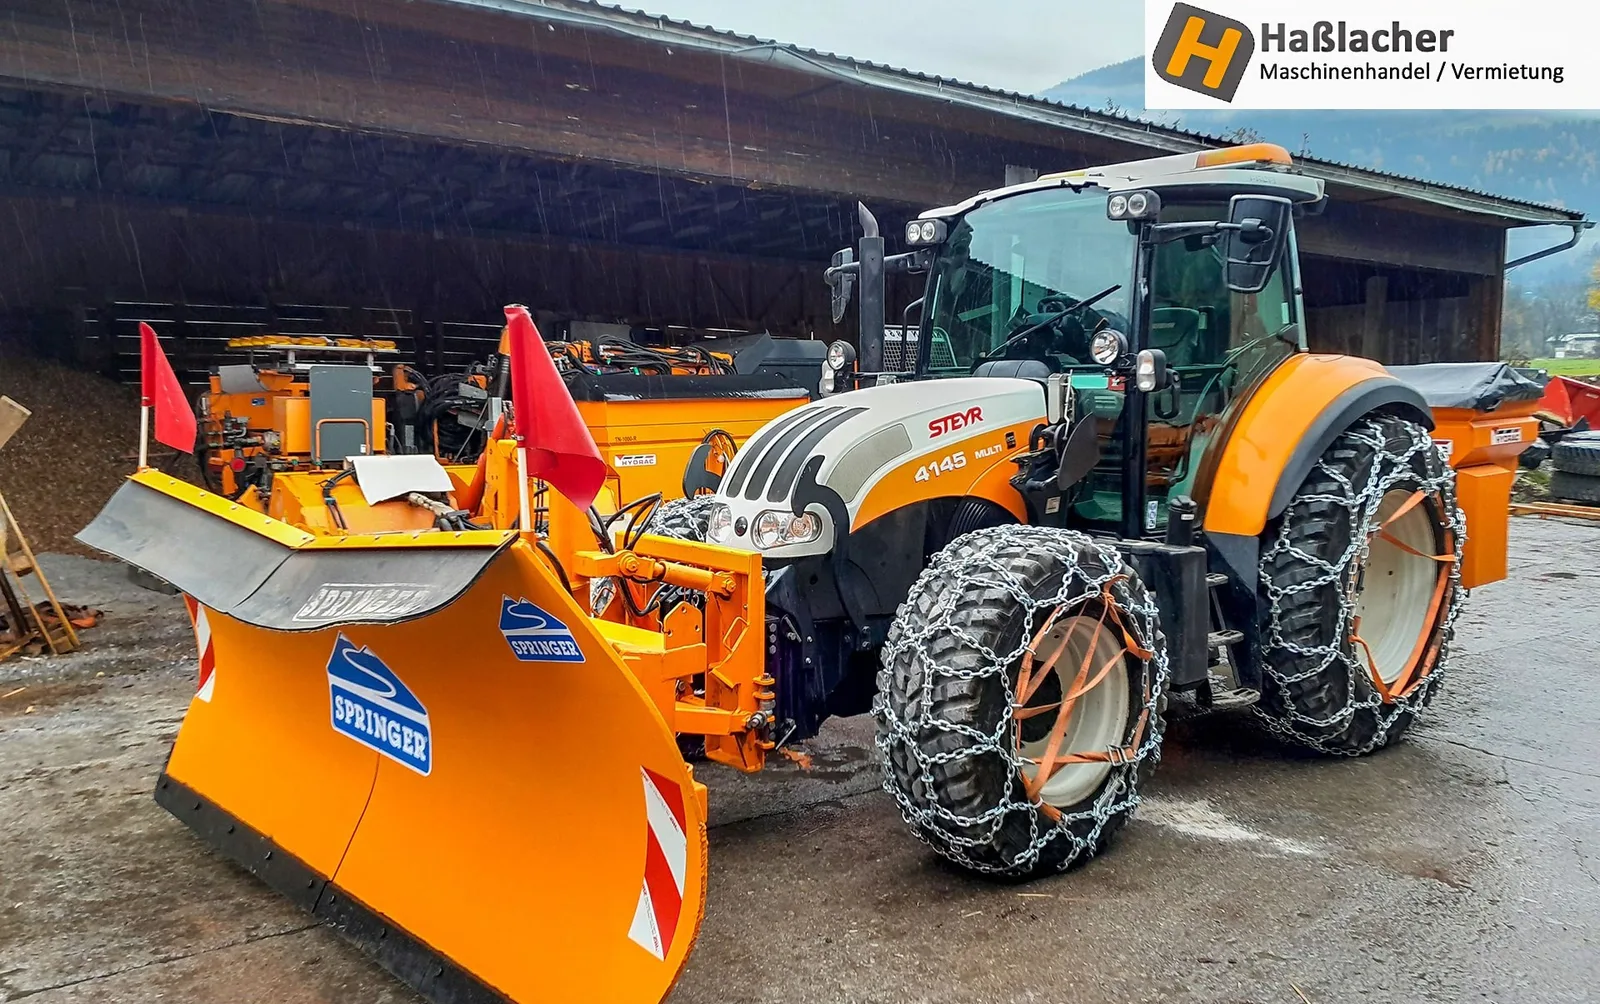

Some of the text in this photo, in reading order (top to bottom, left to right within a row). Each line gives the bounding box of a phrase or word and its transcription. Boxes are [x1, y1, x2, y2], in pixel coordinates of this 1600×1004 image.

[928, 406, 983, 438] STEYR
[914, 444, 1003, 483] 4145 MULTI
[300, 588, 430, 617] SPRINGER
[510, 640, 580, 656] SPRINGER
[335, 694, 427, 762] SPRINGER
